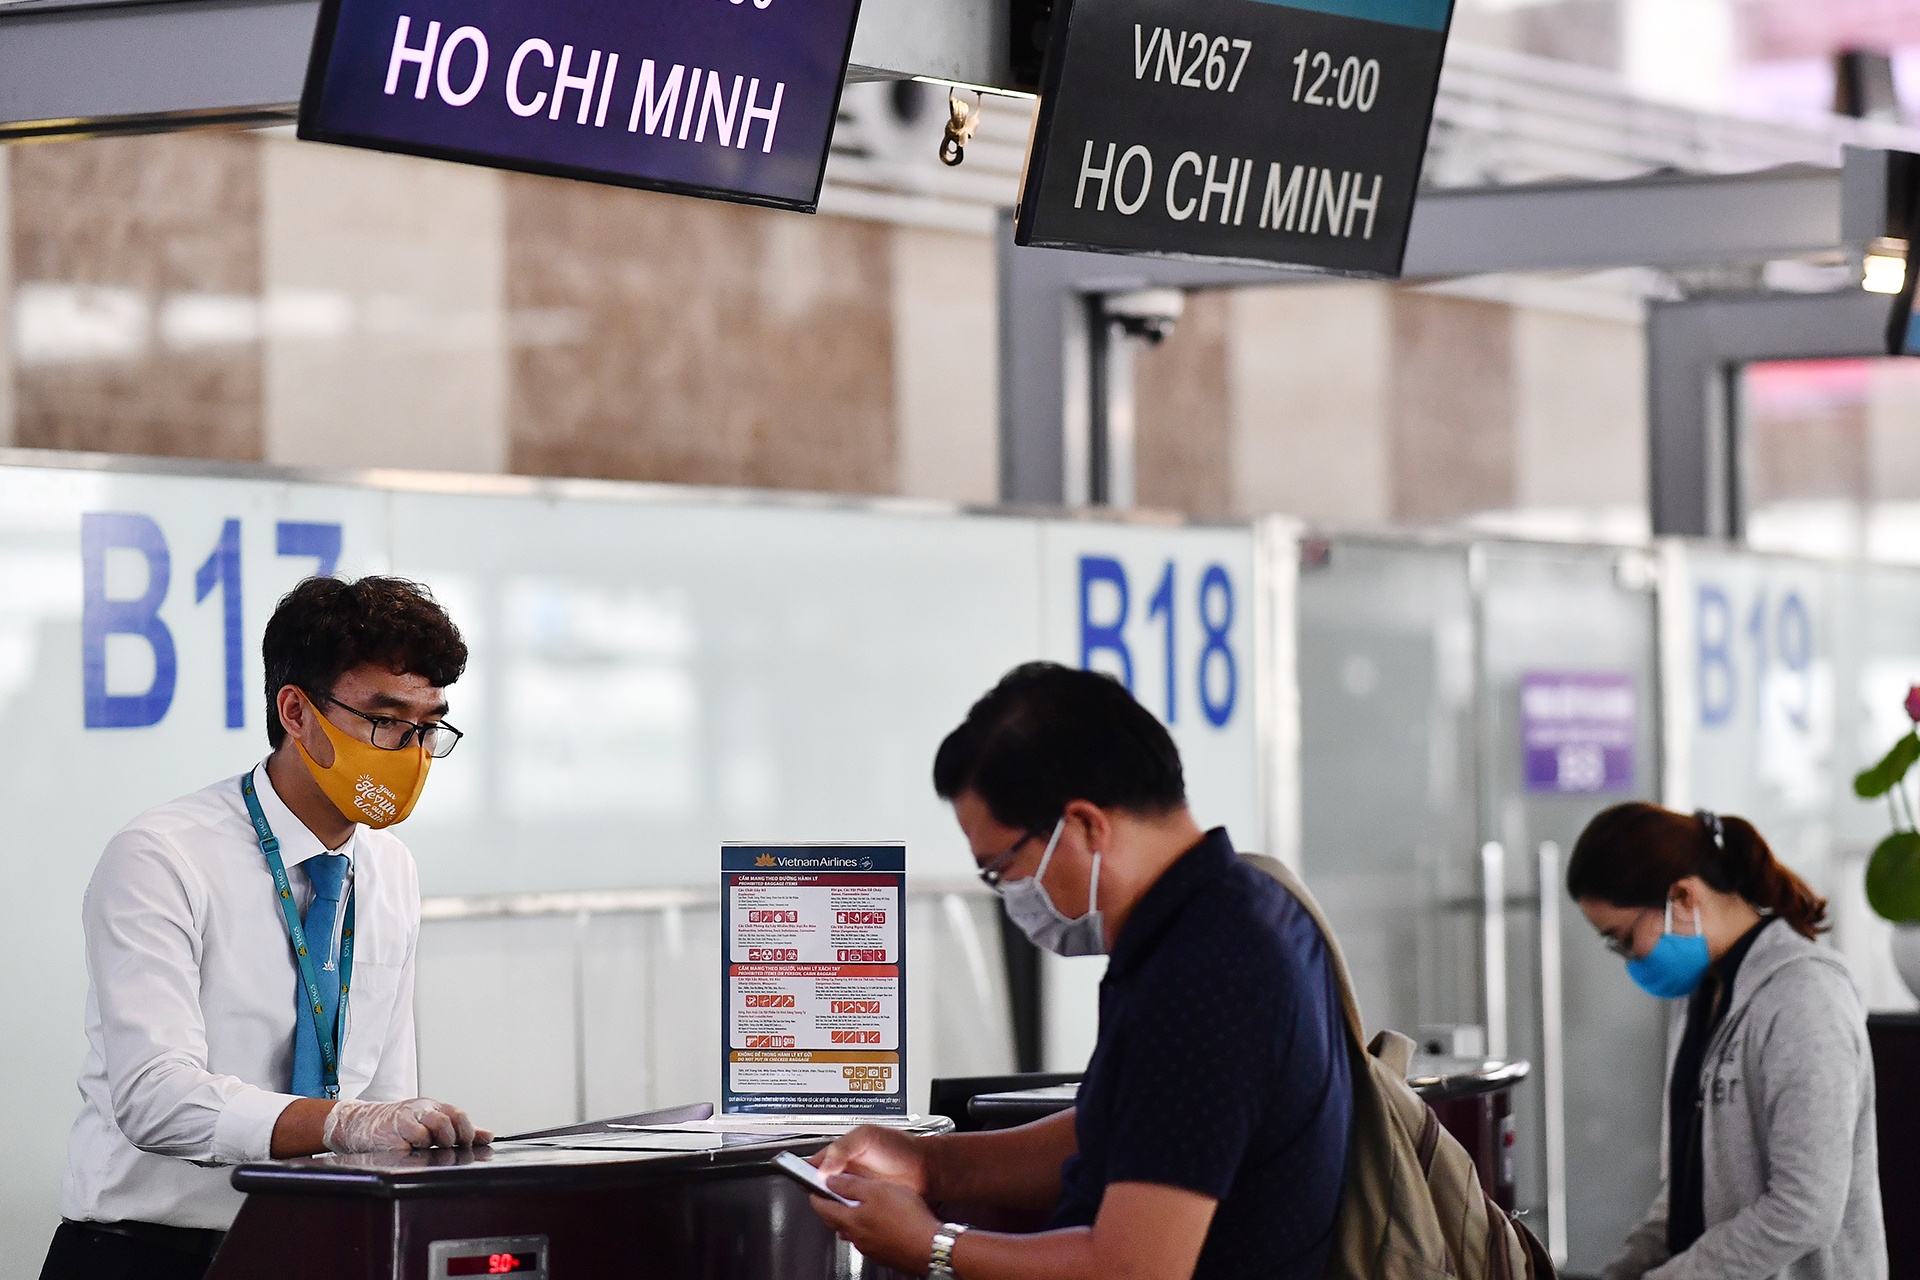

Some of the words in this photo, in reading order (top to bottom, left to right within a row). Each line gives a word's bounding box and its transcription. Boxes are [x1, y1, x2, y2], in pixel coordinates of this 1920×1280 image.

[1134, 23, 1253, 93] VN267
[1292, 47, 1381, 113] 12:00
[383, 14, 490, 108] HO
[505, 37, 620, 128] CHI
[626, 58, 787, 155] MINH
[1073, 139, 1153, 216] HO
[1165, 150, 1254, 227] CHI
[1258, 161, 1383, 241] MINH
[1078, 554, 1238, 729] B18
[1695, 583, 1813, 734] B19
[256, 817, 269, 837] VIAGS
[777, 856, 819, 867] Vietnam
[819, 856, 858, 867] Airlines
[276, 869, 286, 889] VIAGS
[293, 926, 304, 947] VIAGS
[310, 984, 319, 1005] VIAGS
[323, 1042, 332, 1063] VIAGS
